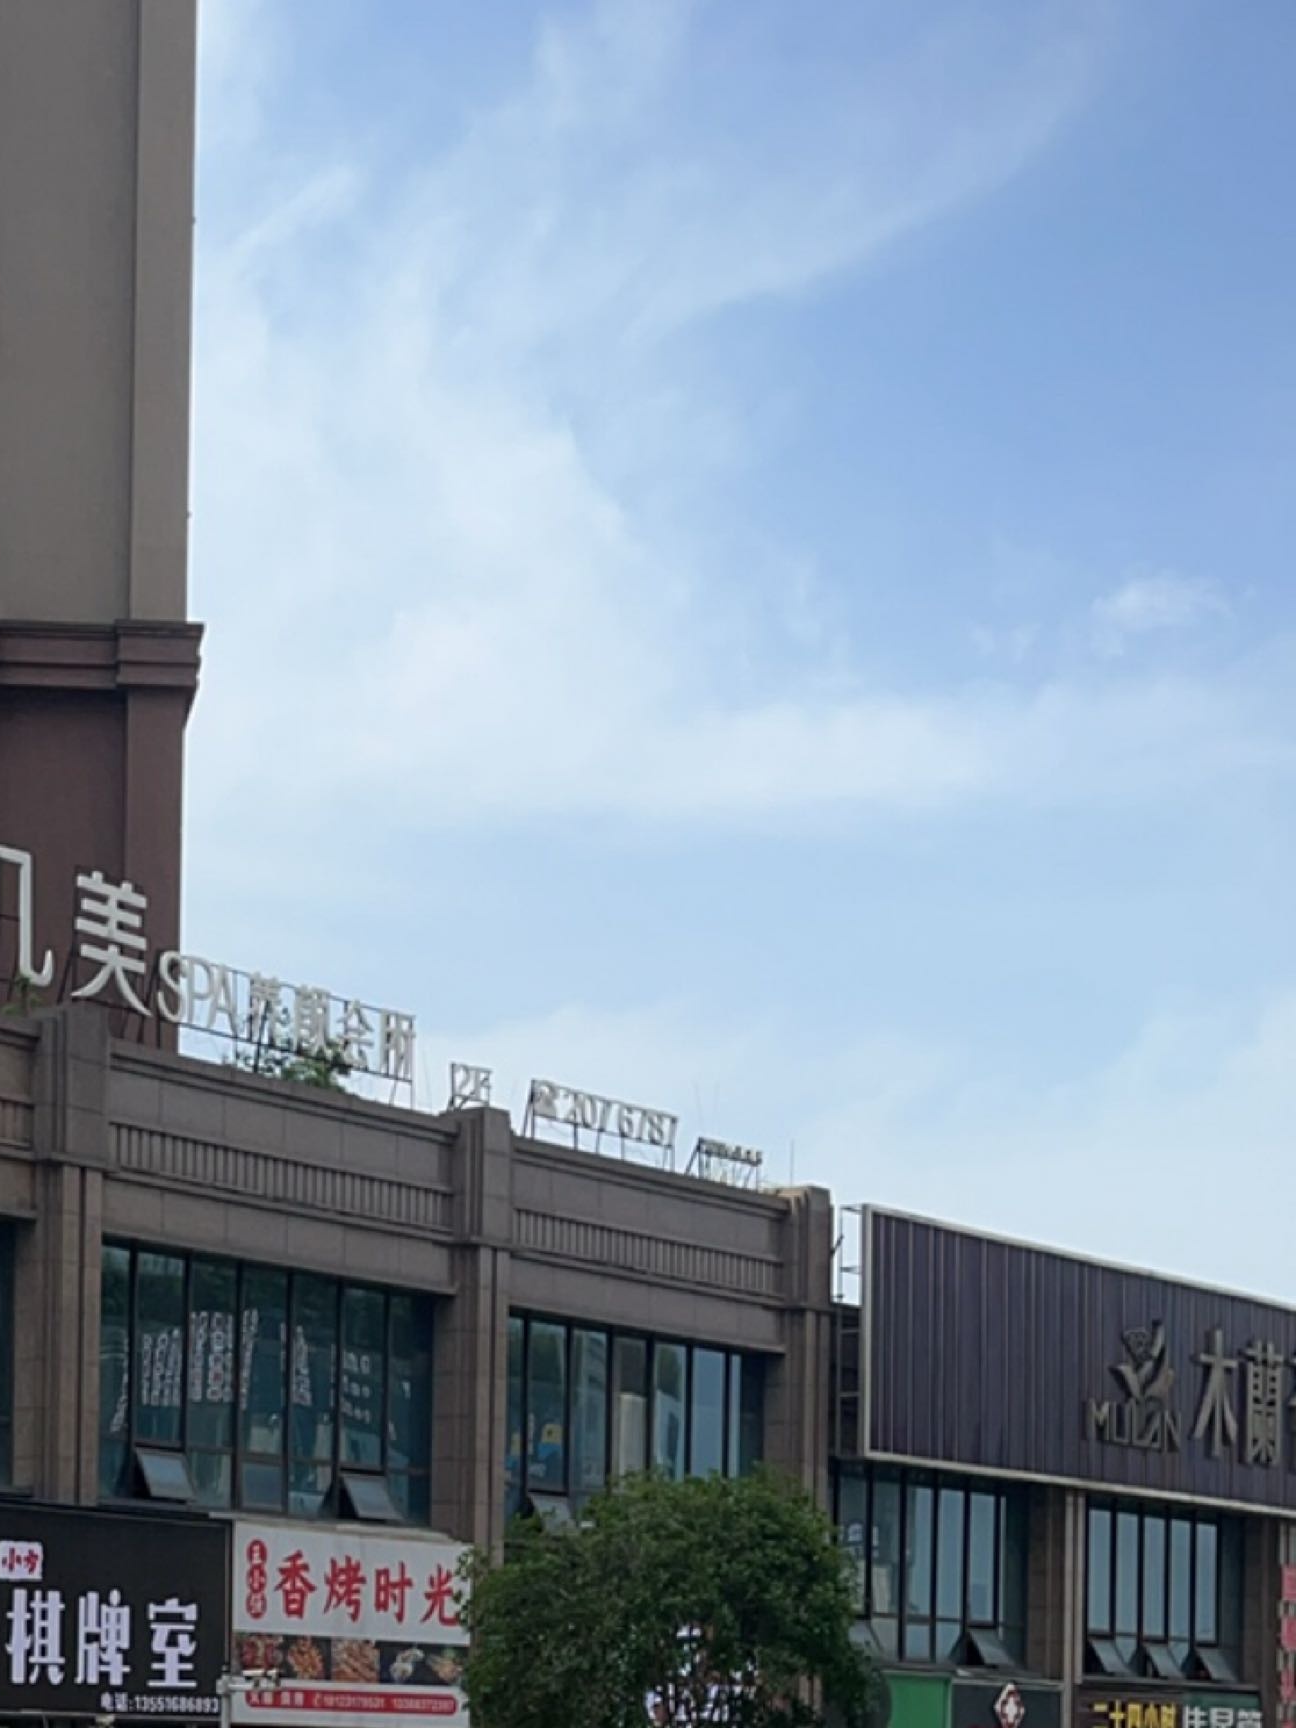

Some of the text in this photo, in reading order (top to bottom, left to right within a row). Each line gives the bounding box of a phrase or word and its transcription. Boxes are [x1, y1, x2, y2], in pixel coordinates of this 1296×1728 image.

[1087, 1398, 1182, 1452] MULAN
[1194, 1329, 1296, 1465] 木蘭
[1, 1550, 39, 1574] 小方
[274, 1549, 461, 1626] 香烤时光
[5, 1588, 198, 1688] 棋牌室
